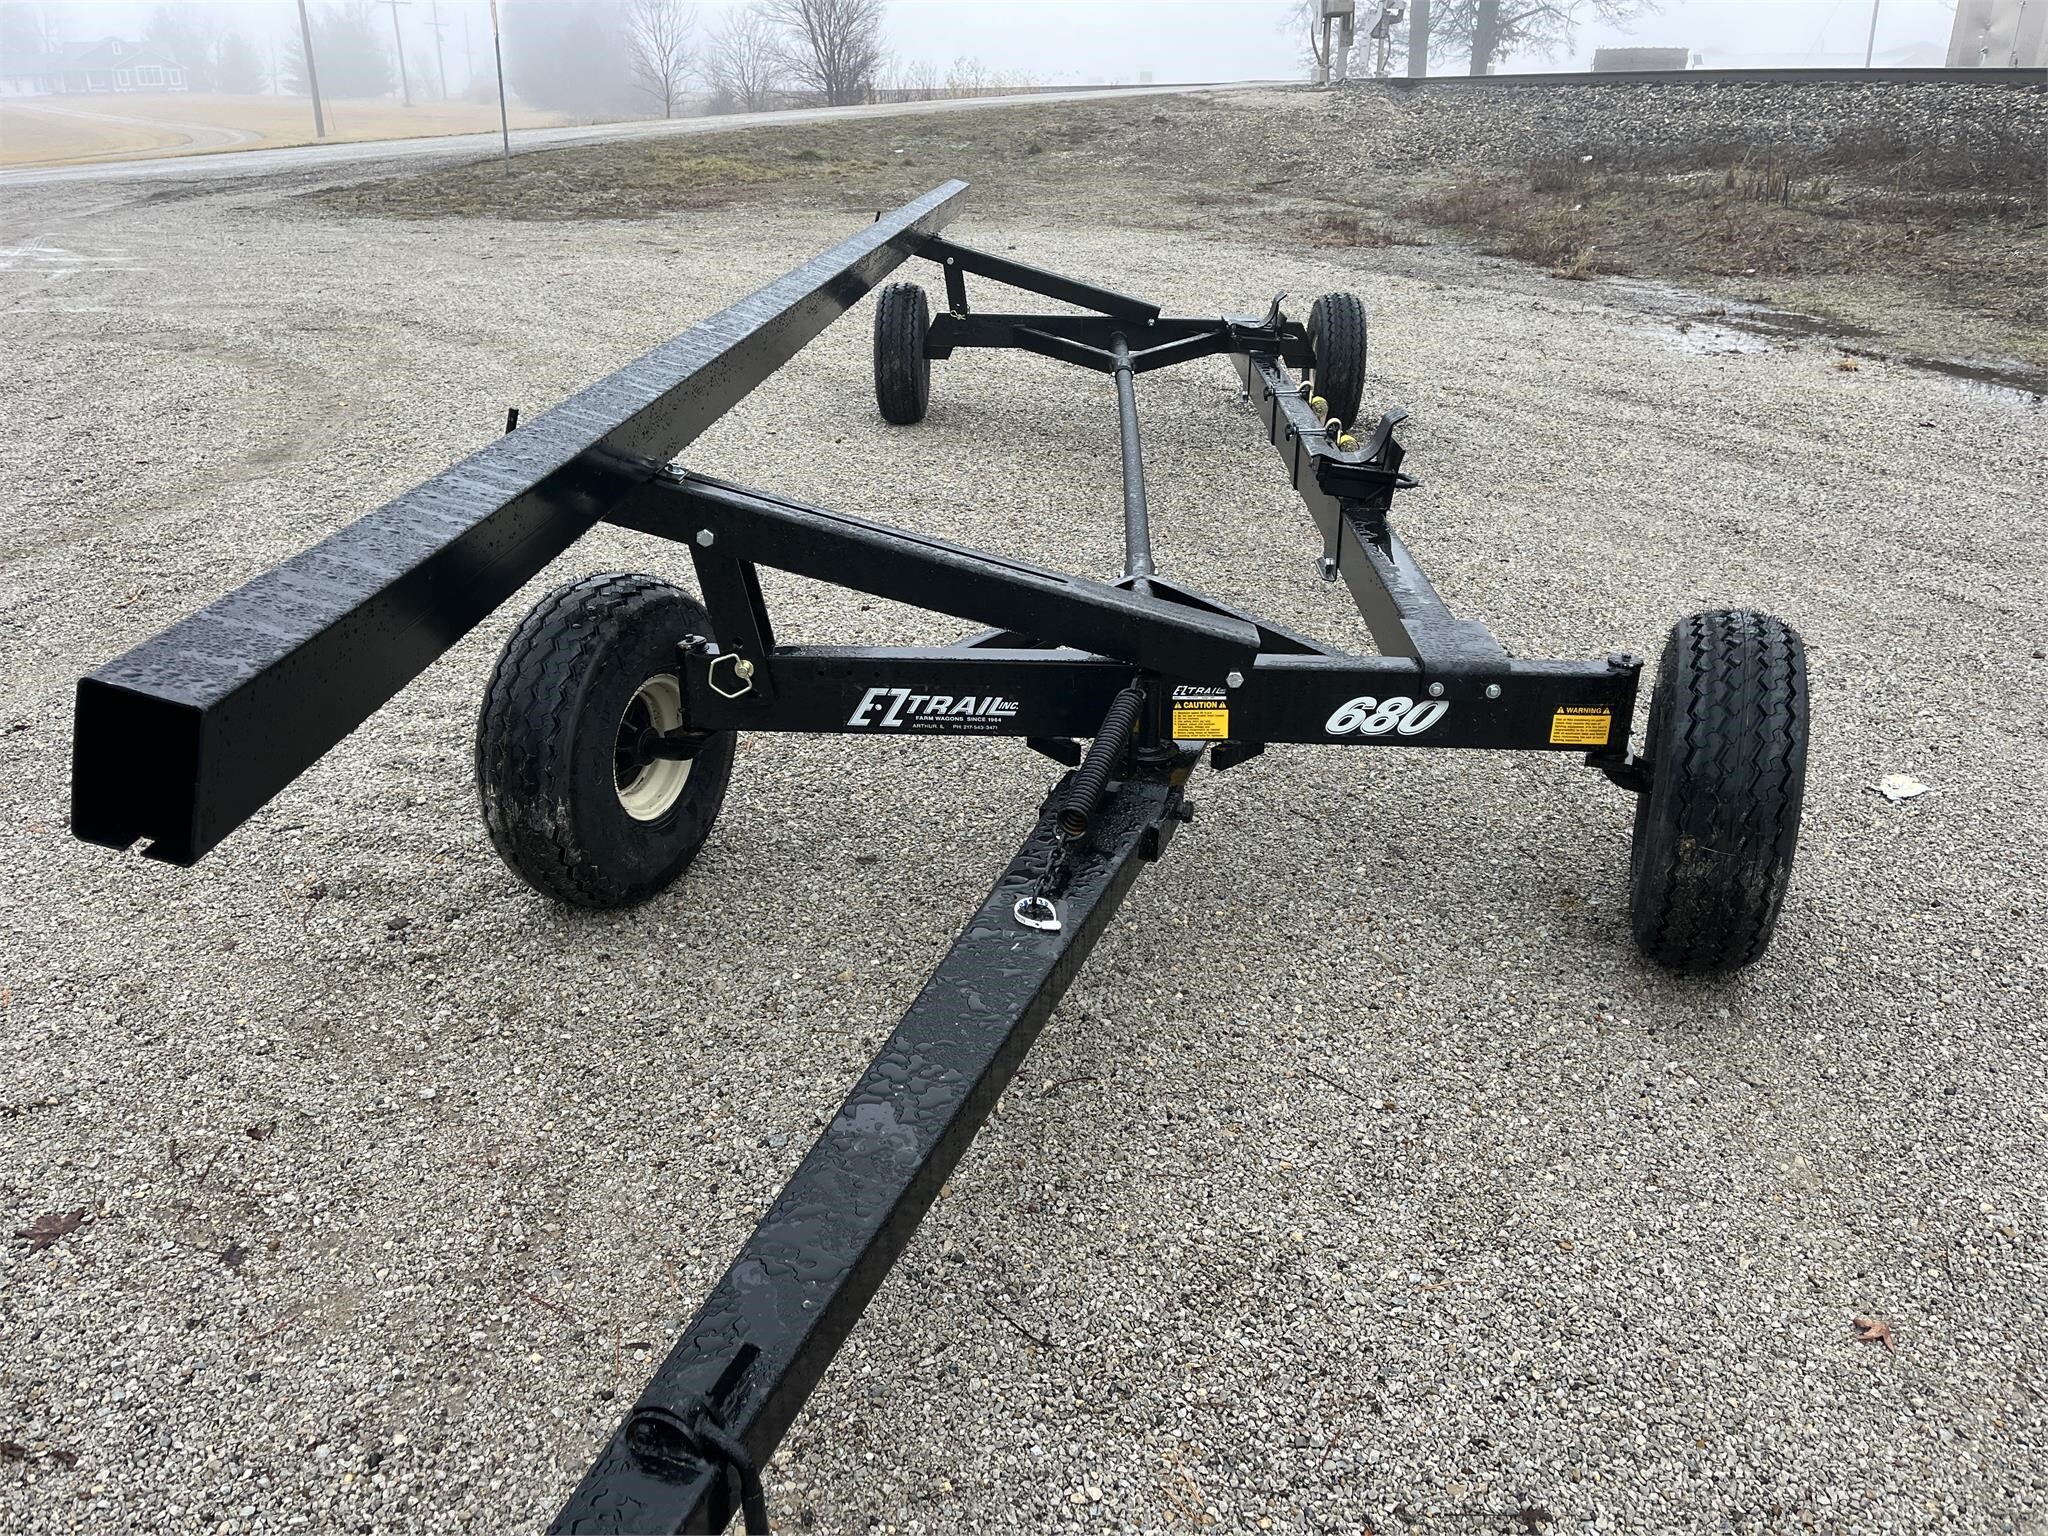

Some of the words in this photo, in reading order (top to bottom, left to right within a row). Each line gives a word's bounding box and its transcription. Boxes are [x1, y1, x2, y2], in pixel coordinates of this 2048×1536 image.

[1187, 686, 1226, 695] TRAIL
[906, 695, 1017, 717] TRAIL
[998, 701, 1019, 711] INC.
[1183, 701, 1218, 709] CAUTION
[1325, 696, 1450, 735] 680
